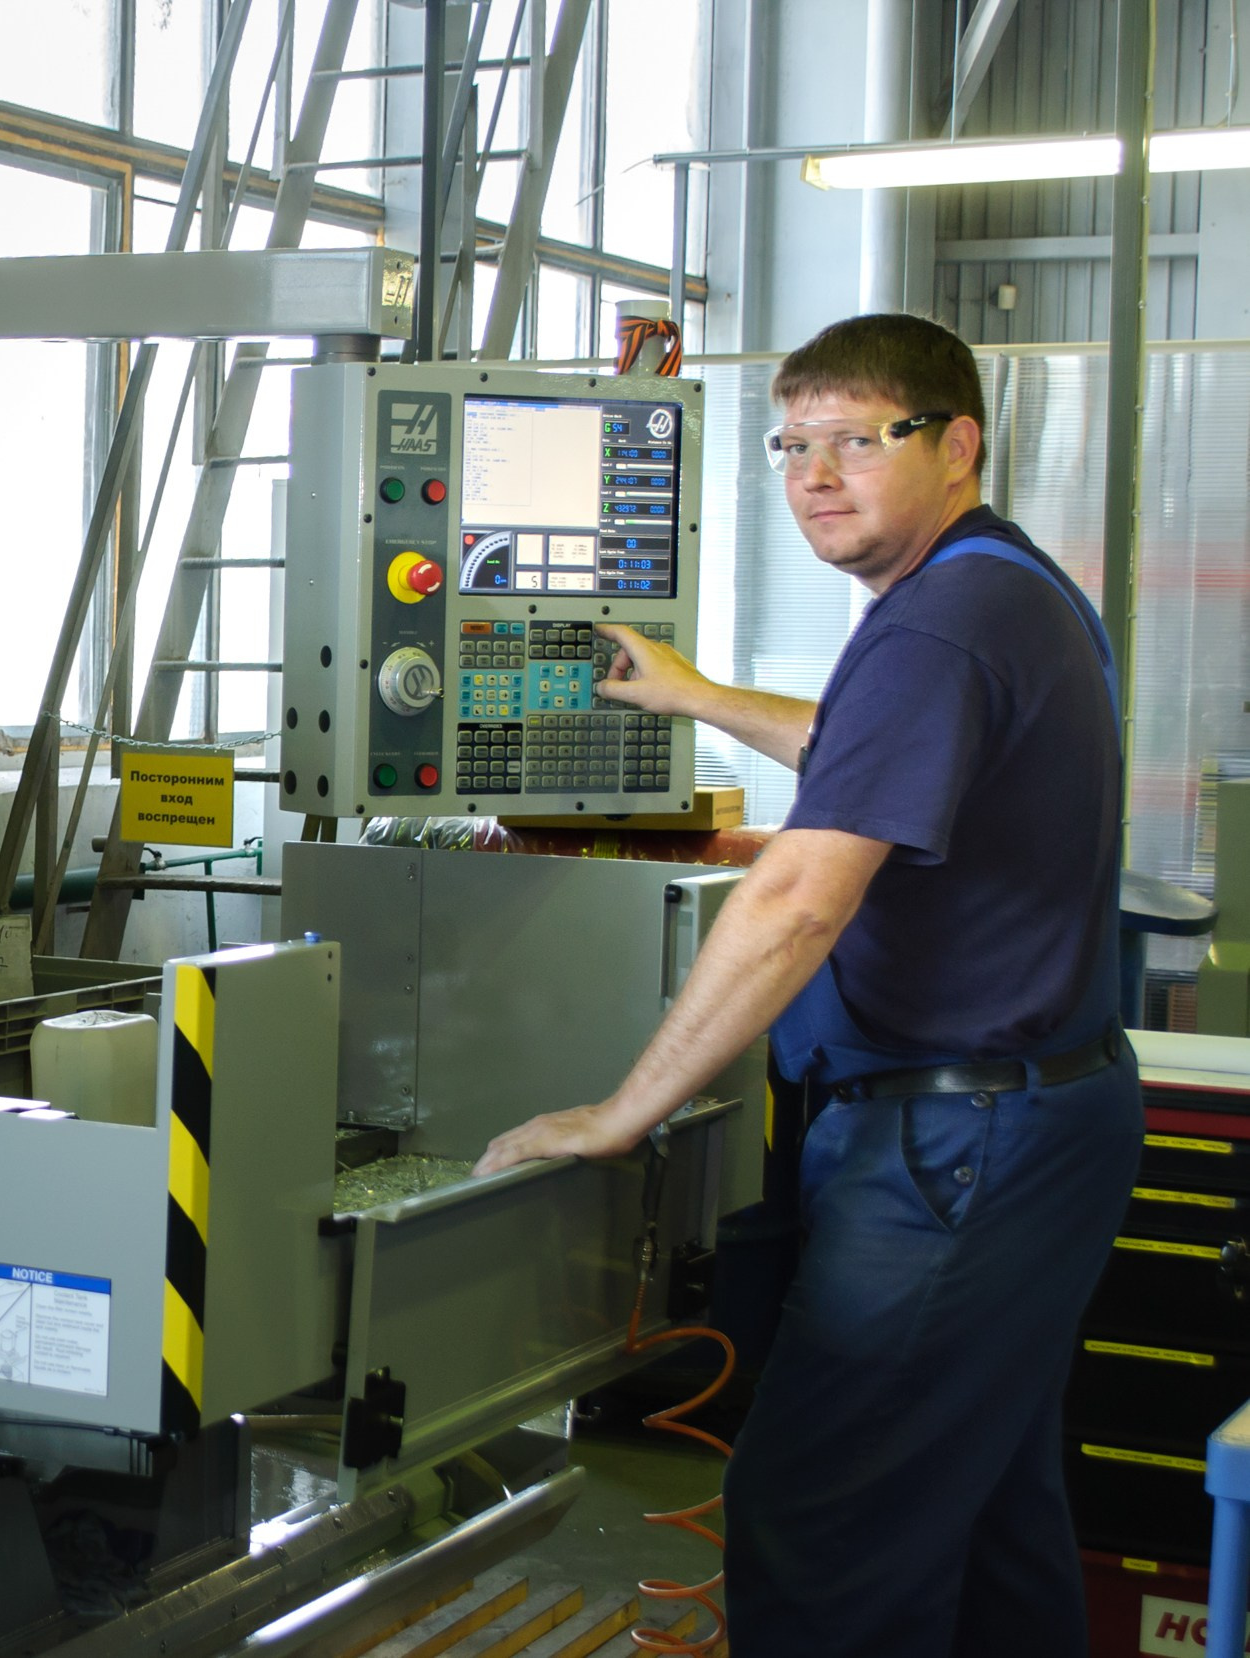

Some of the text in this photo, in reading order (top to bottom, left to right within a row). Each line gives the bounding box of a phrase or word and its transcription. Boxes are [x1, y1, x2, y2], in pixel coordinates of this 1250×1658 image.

[604, 422, 611, 433] G
[392, 438, 437, 452] HAAS
[604, 447, 611, 457] X
[604, 475, 610, 485] Y
[602, 503, 610, 513] Z
[130, 770, 225, 786] Посторонним
[160, 794, 194, 806] вход
[137, 812, 216, 826] воспрещен
[12, 1267, 54, 1284] NOTICE
